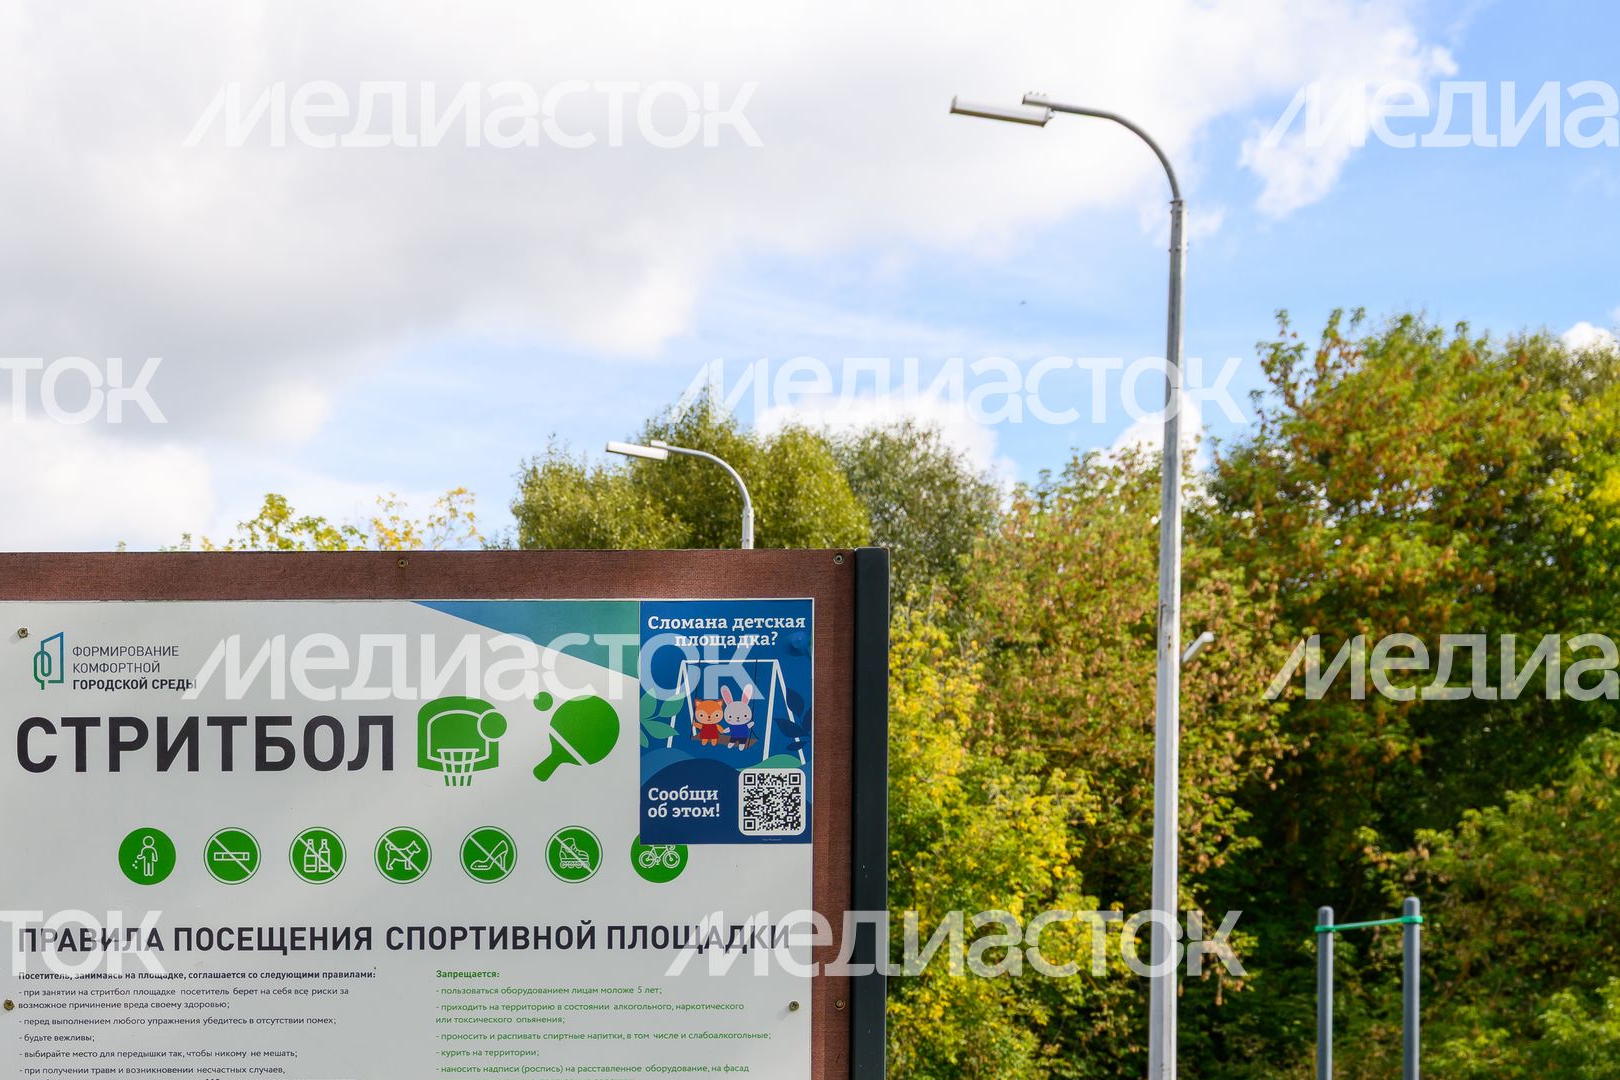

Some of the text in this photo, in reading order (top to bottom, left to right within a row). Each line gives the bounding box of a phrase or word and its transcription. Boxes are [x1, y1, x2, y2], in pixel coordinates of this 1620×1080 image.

[647, 615, 806, 632] Сломана детская
[674, 631, 779, 649] площадка?
[72, 645, 179, 657] ФОРМИРОВАНИЕ
[72, 660, 161, 674] КОМФОРТНОЙ
[72, 677, 197, 692] ГОРОДСКОЙ СРЕДЫ
[16, 715, 394, 774] СТРИТБОЛ
[647, 785, 719, 803] Сообщи
[647, 802, 721, 818] об этом!
[18, 919, 791, 956] ПРАВИЛА ПОСЕЩЕНИЯ СПОРТИВНОЙ ПЛОЩАДКИ
[137, 972, 187, 980] площадке,
[259, 971, 320, 981] следующими
[321, 971, 376, 981] правилами:
[435, 968, 500, 980] Запрещается:
[499, 985, 570, 996] оборудованием
[570, 987, 599, 995] лицам
[643, 987, 662, 996] лет;
[67, 1002, 122, 1011] причинение
[122, 1001, 149, 1011] вреда
[149, 1001, 182, 1011] своему
[183, 1001, 230, 1010] здоровью;
[514, 1016, 565, 1025] опьянения;
[22, 1032, 95, 1044] будьте вежливы;
[440, 1049, 471, 1058] курить
[482, 1049, 540, 1058] территории;
